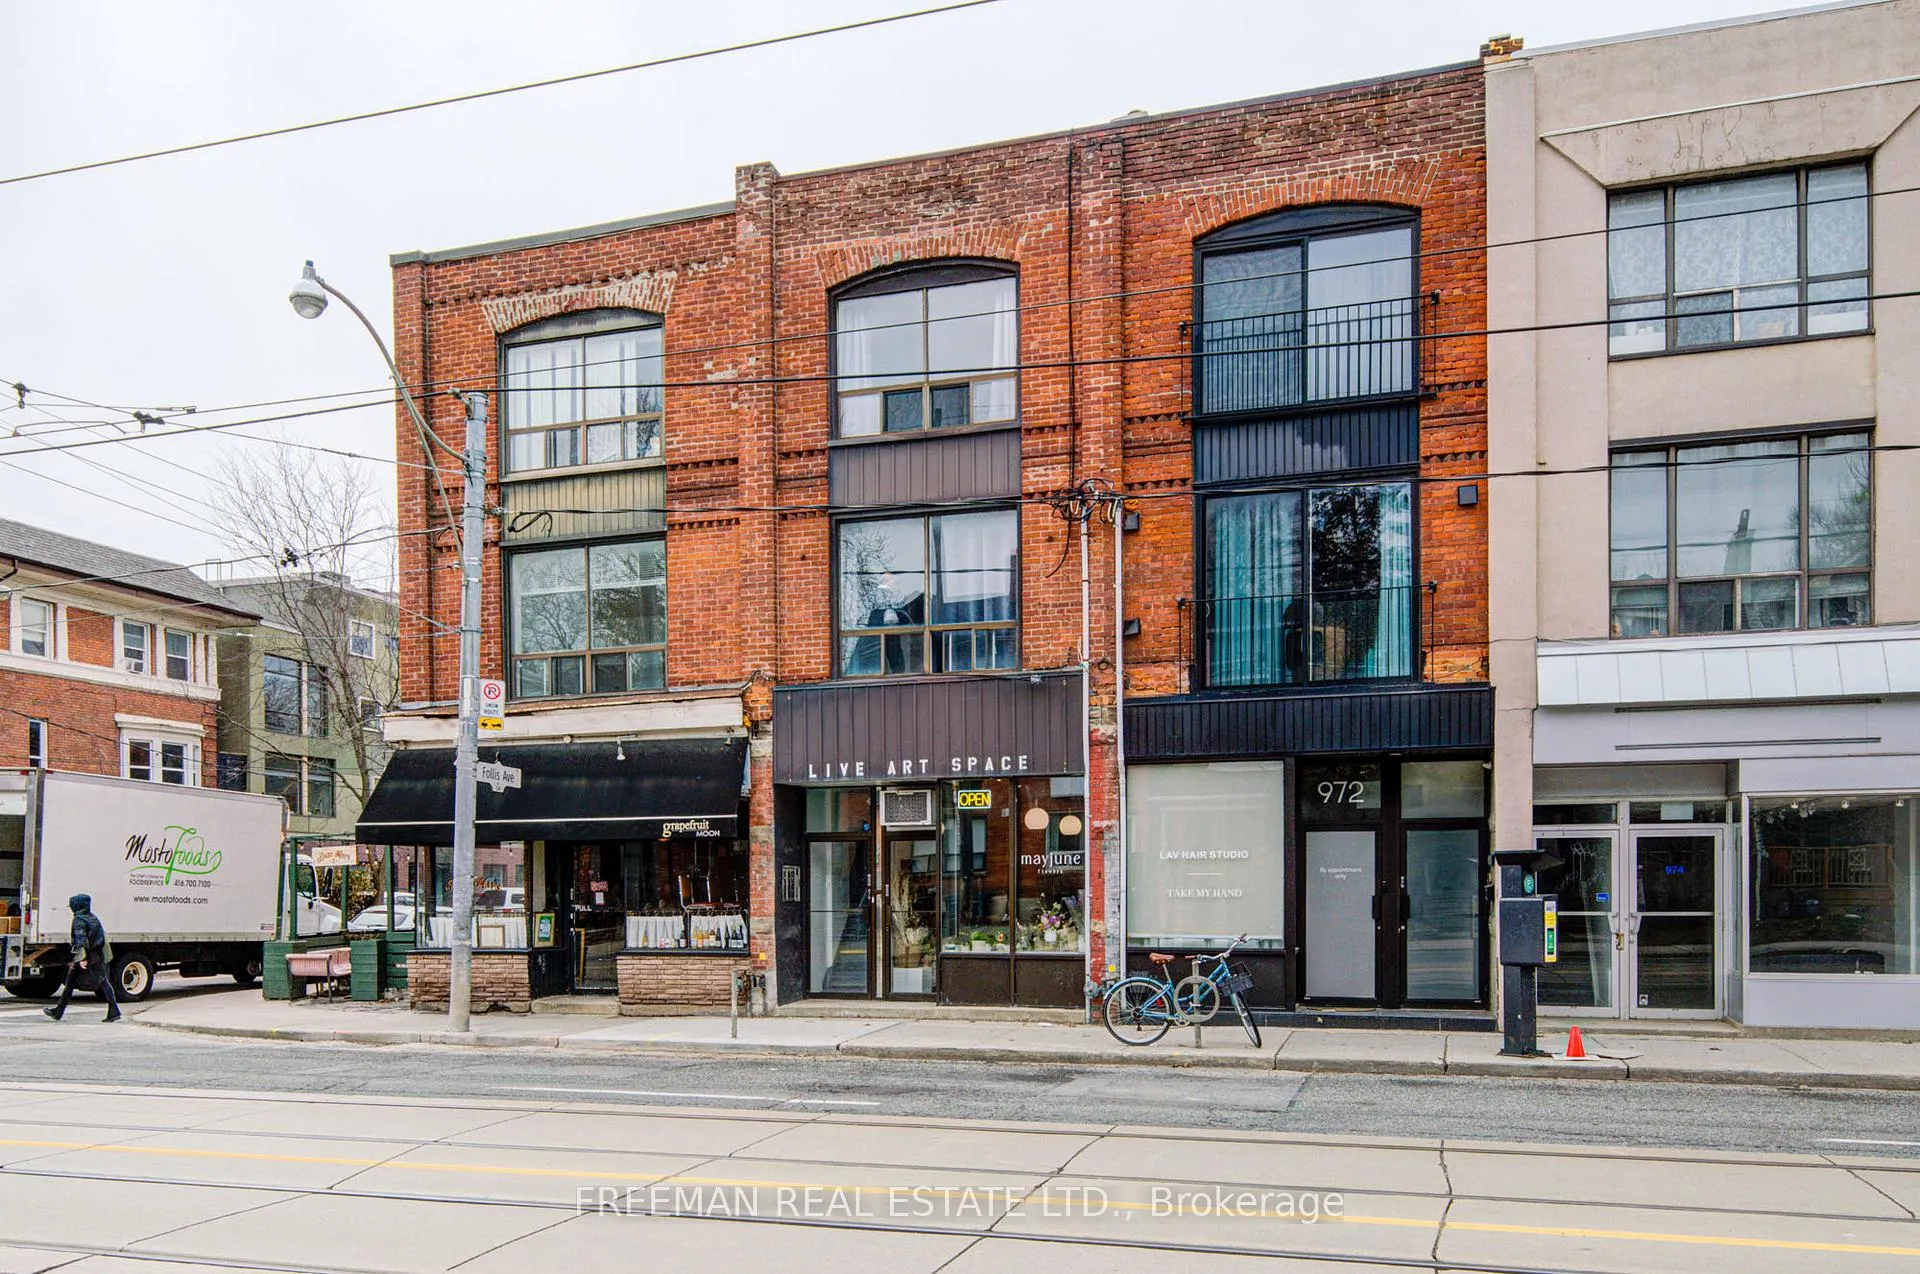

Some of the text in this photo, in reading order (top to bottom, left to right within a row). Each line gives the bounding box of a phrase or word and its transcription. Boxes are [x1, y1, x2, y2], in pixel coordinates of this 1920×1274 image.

[808, 755, 1028, 778] LIVE ART SPACE
[482, 766, 515, 783] Follis Ave
[959, 792, 990, 807] OPEN
[1317, 781, 1364, 803] 972
[662, 819, 710, 838] grapefruit
[1021, 853, 1081, 868] mayjune
[1160, 850, 1249, 859] LAV HAIR STUDIO
[1665, 865, 1685, 874] 974
[1168, 888, 1243, 898] TAKE MY HAND
